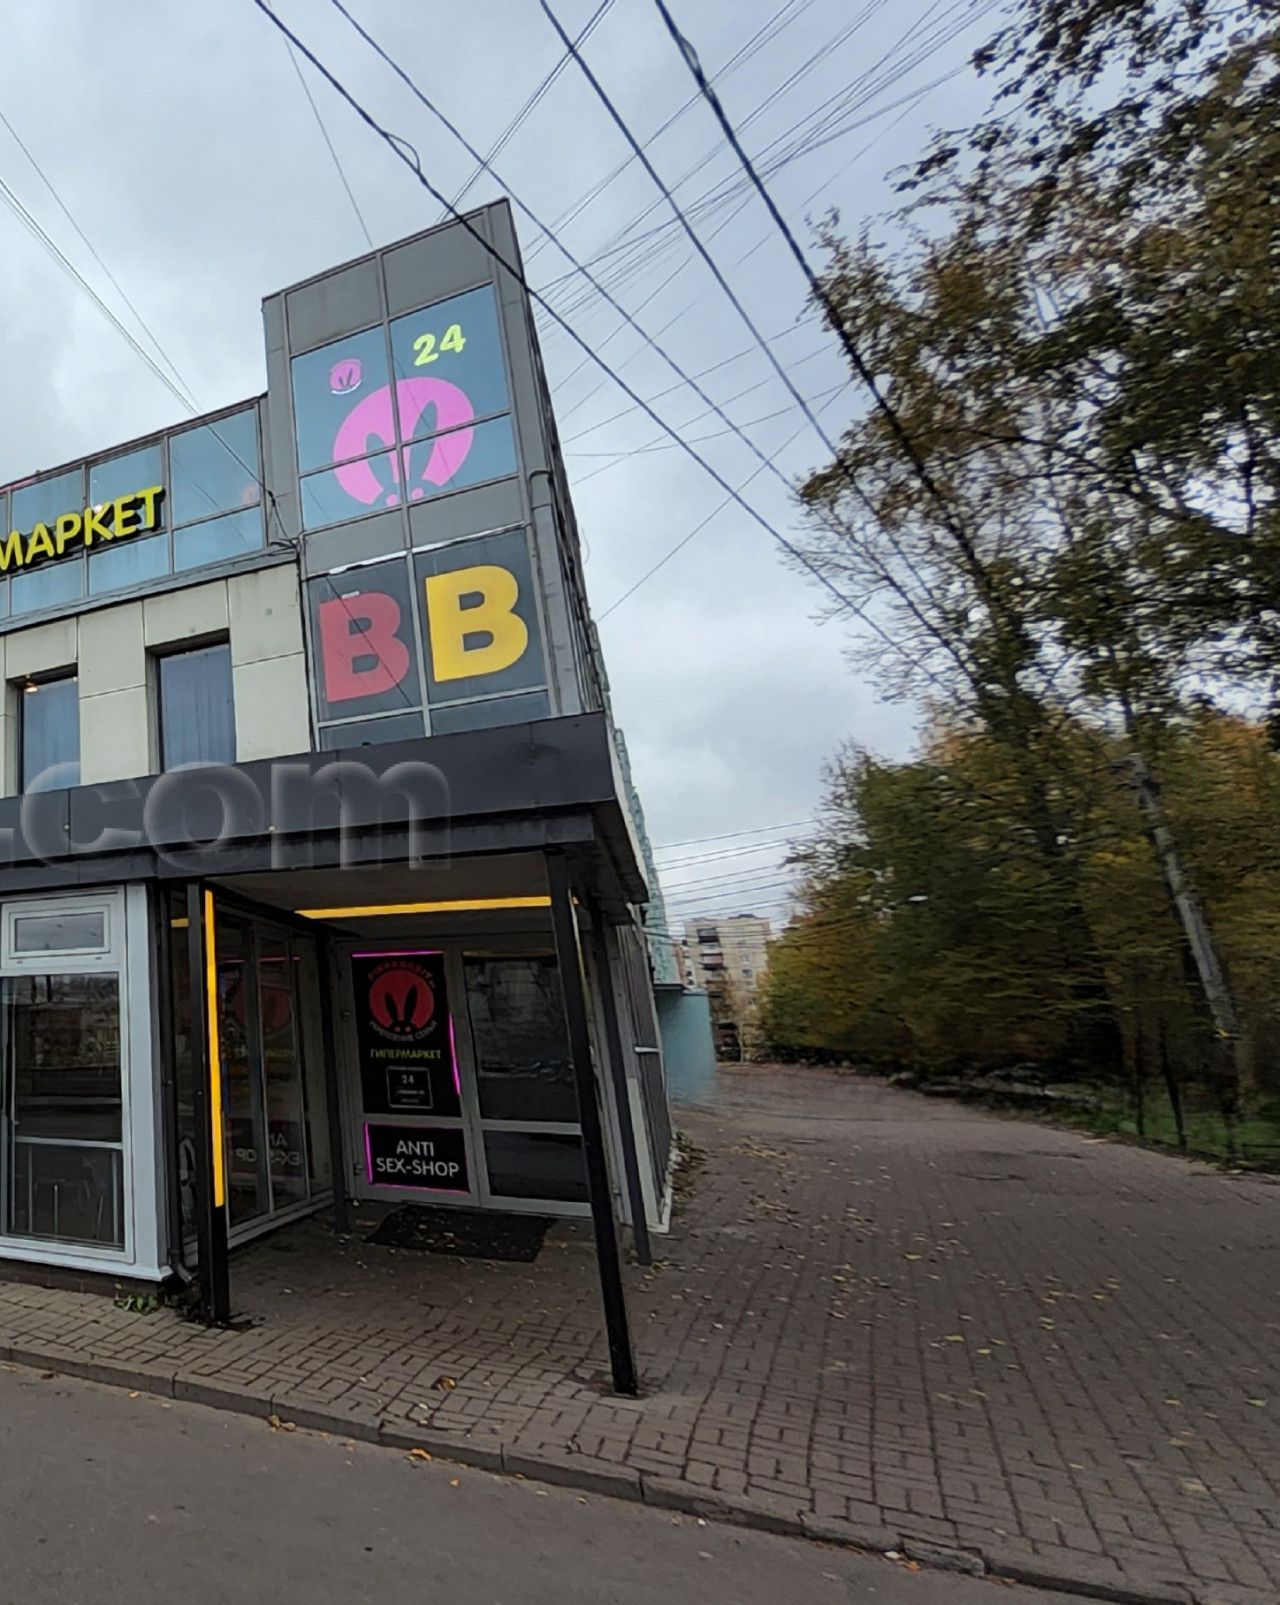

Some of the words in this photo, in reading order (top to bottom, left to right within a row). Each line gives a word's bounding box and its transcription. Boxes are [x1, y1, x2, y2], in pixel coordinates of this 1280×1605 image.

[413, 324, 467, 366] 24
[370, 1048, 441, 1060] ГИПЕРМАРКЕТ
[396, 1140, 435, 1157] ANTI
[376, 1157, 460, 1178] SEX-SHOP
